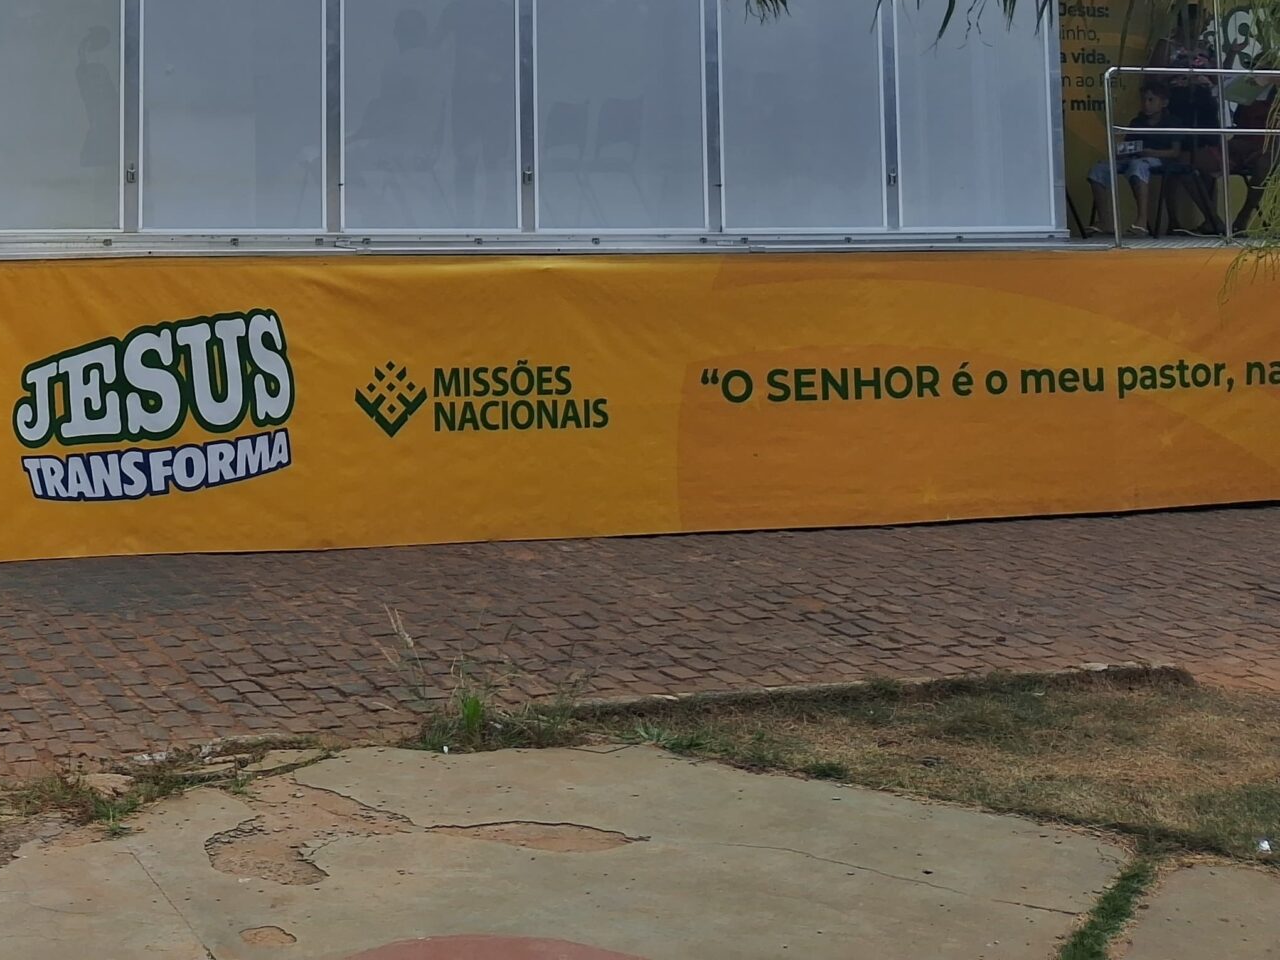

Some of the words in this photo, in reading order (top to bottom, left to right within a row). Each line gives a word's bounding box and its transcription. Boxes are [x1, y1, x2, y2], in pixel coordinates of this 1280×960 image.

[1059, 25, 1100, 43] inho,
[1072, 48, 1111, 64] vida.
[1076, 76, 1095, 88] ao
[15, 311, 292, 445] JESUS
[433, 359, 572, 397] MISSÕES
[766, 365, 940, 402] SENHOR
[951, 361, 974, 396] é
[985, 370, 1008, 394] o
[1020, 367, 1104, 393] meu
[1117, 359, 1234, 399] pastor,
[433, 398, 609, 432] NACIONAIS
[22, 428, 291, 501] TRANSFORMA
